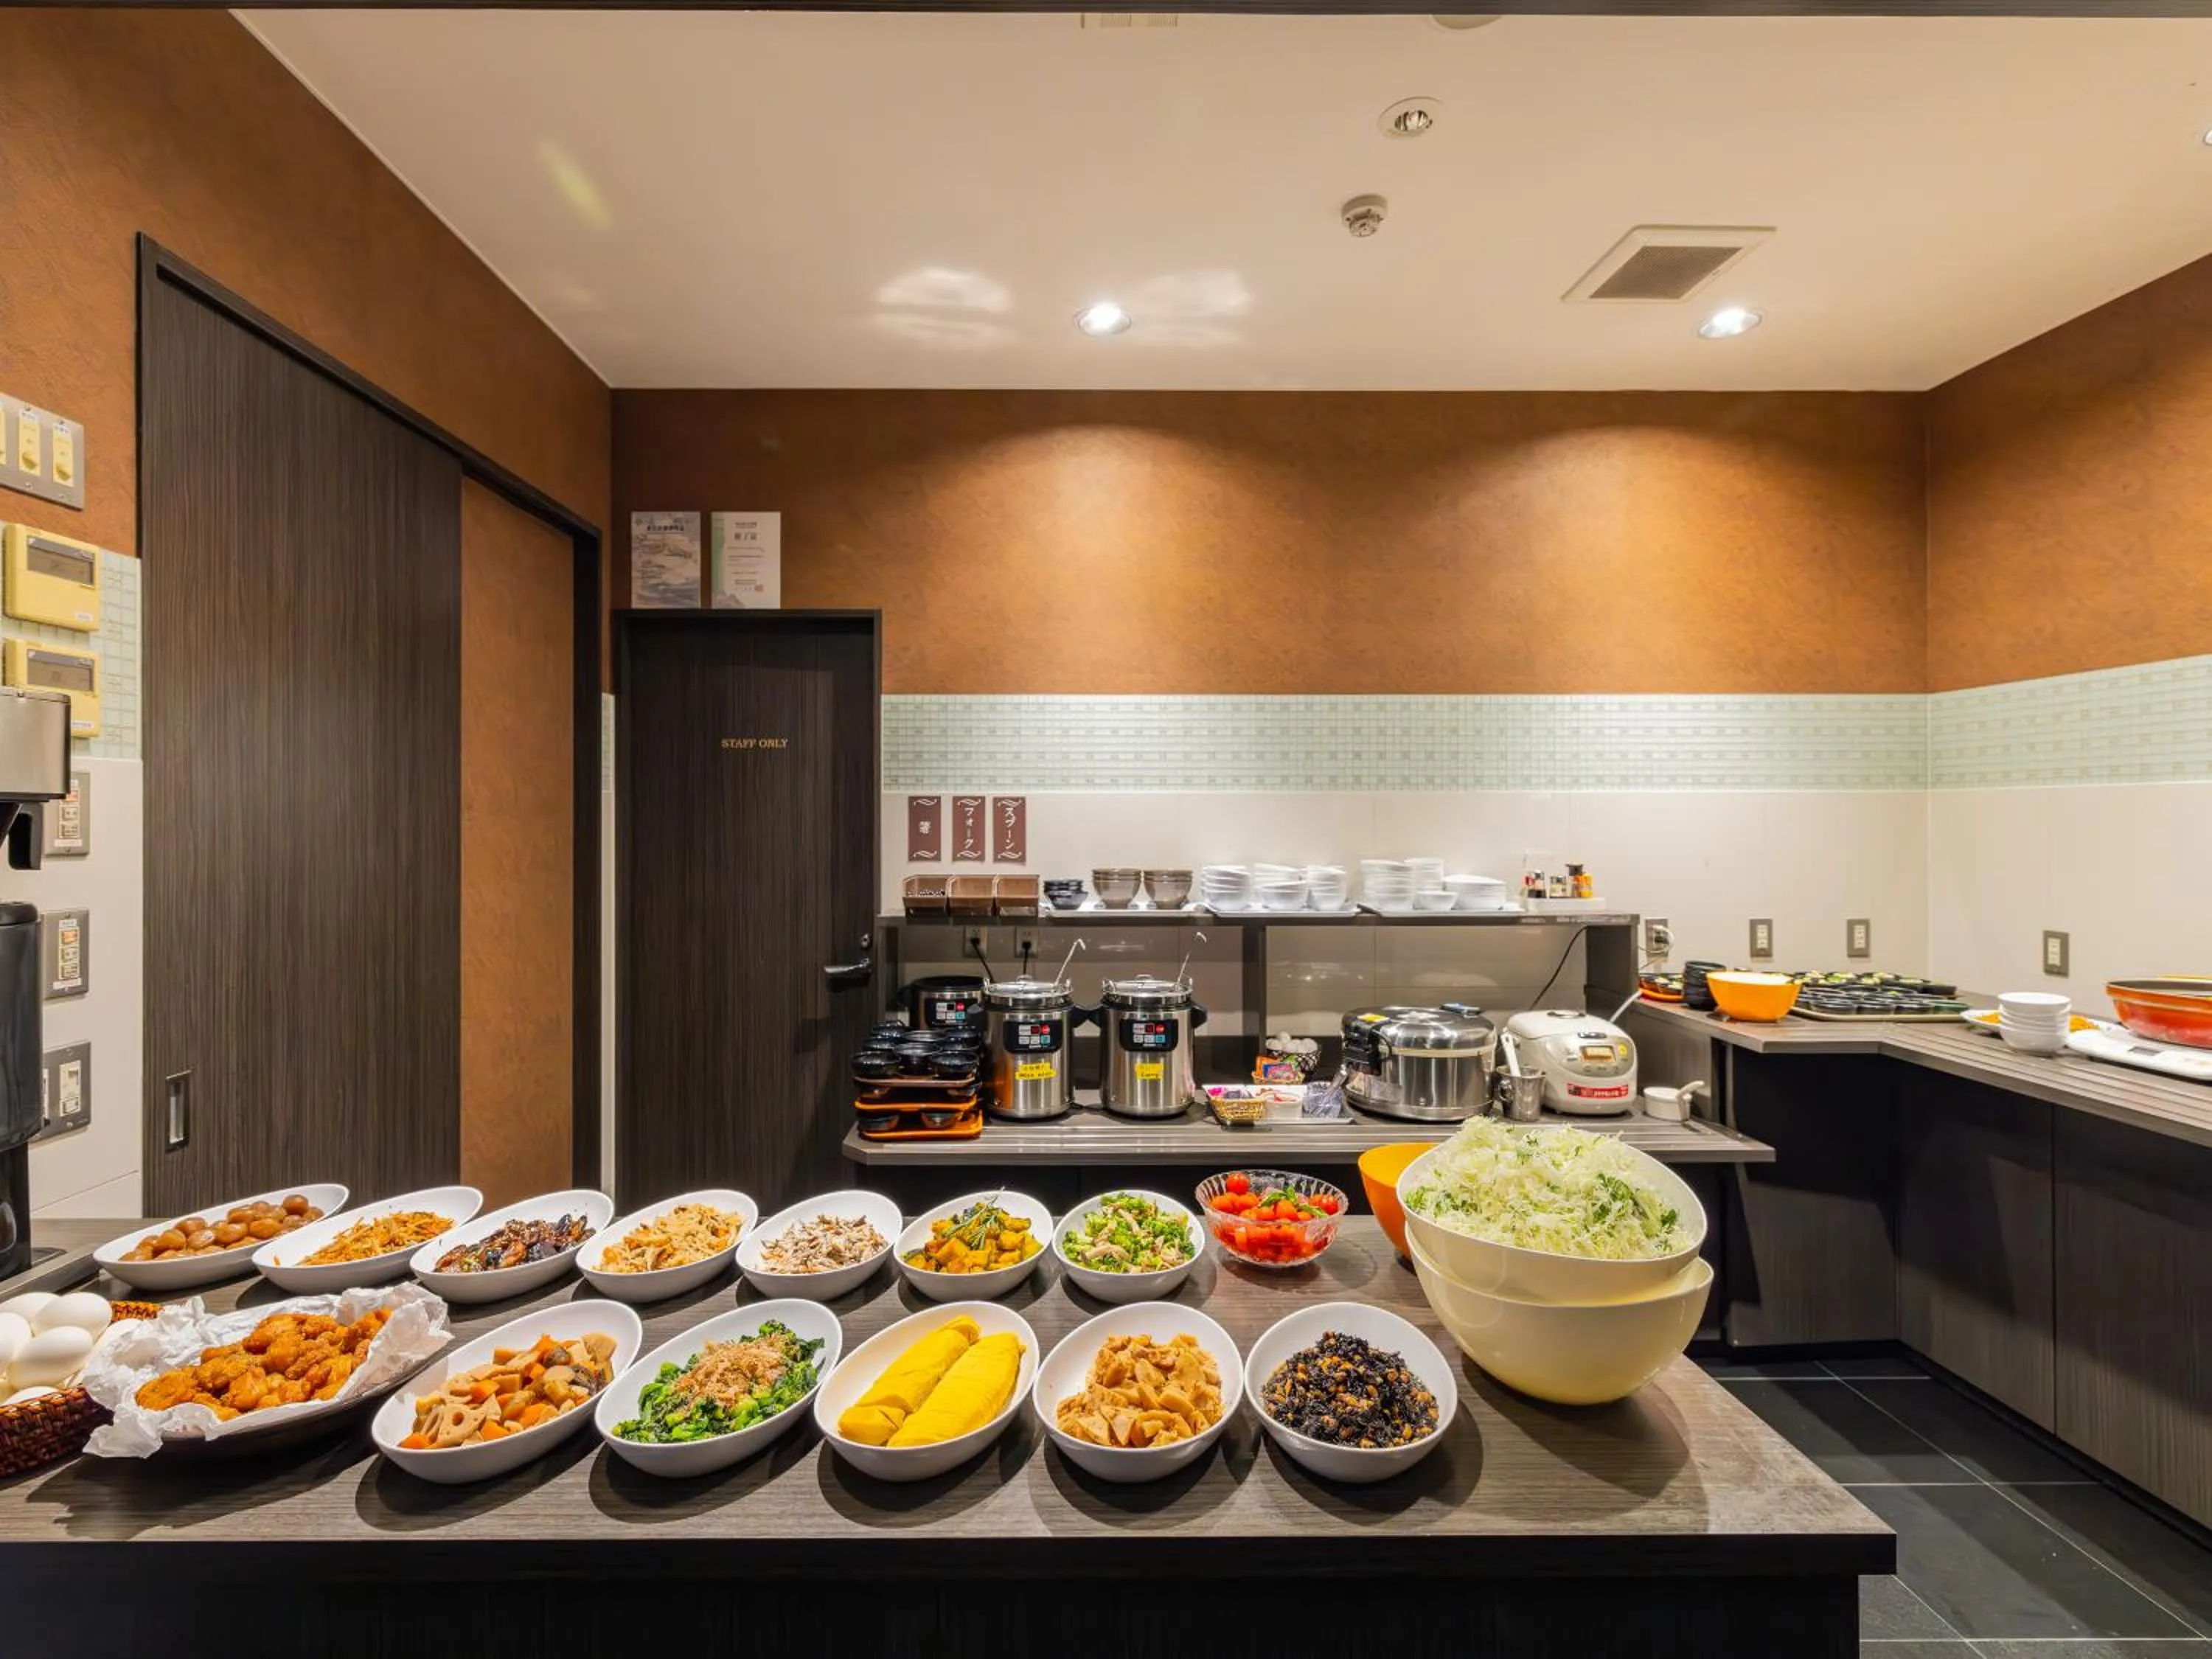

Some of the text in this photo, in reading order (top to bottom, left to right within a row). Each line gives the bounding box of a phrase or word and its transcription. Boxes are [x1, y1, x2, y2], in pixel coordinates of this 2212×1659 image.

[721, 738, 788, 748] STAFF ONLY
[964, 807, 974, 849] フォーク
[1005, 807, 1016, 849] スプーン
